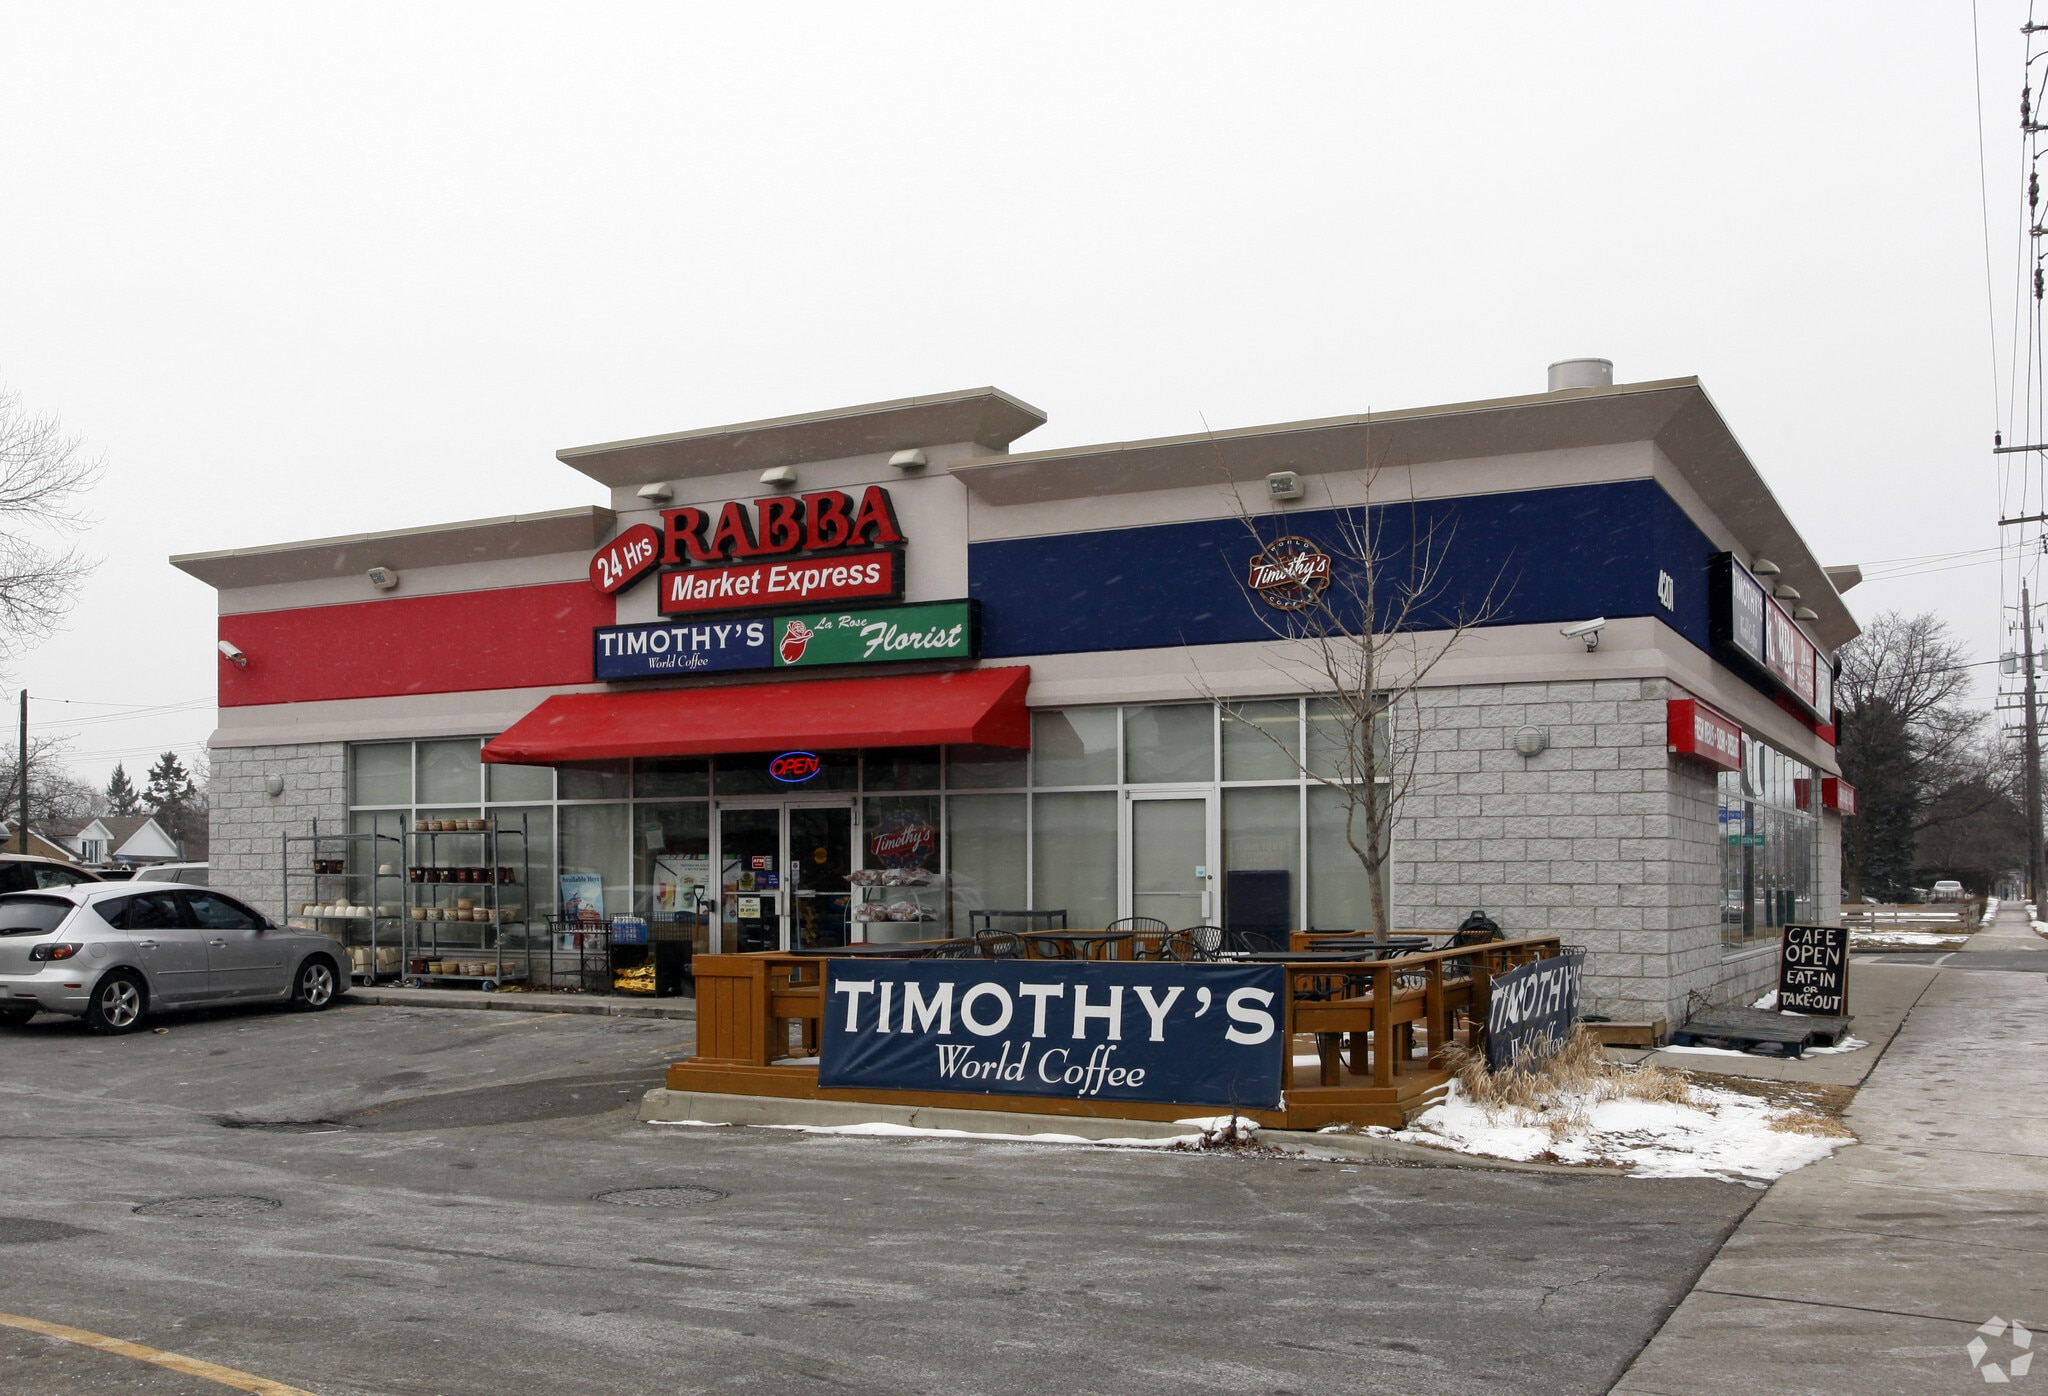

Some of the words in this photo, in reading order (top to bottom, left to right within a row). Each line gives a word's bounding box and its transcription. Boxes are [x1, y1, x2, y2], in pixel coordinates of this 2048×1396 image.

[659, 485, 900, 564] RABBA
[597, 548, 623, 588] 24
[623, 537, 652, 569] Hrs
[1253, 552, 1327, 588] Timothy's
[671, 569, 761, 601] Market
[767, 563, 881, 596] Express
[1657, 569, 1674, 612] 4201
[600, 622, 765, 656] TIMOTHY'S
[814, 617, 833, 630] La
[838, 615, 867, 629] Rose
[859, 621, 963, 658] Florist
[648, 654, 676, 669] World
[678, 652, 709, 669] Coffee
[771, 756, 819, 775] OPEN
[873, 823, 931, 855] Timothy's
[1788, 928, 1836, 945] CAFE
[1785, 945, 1840, 966] OPEN
[1786, 970, 1836, 988] EAT-IN
[834, 979, 1275, 1045] TIMOTHY'S
[1780, 992, 1841, 1010] TAKE-OUT
[936, 1041, 1030, 1081] World
[1038, 1044, 1145, 1096] Coffee
